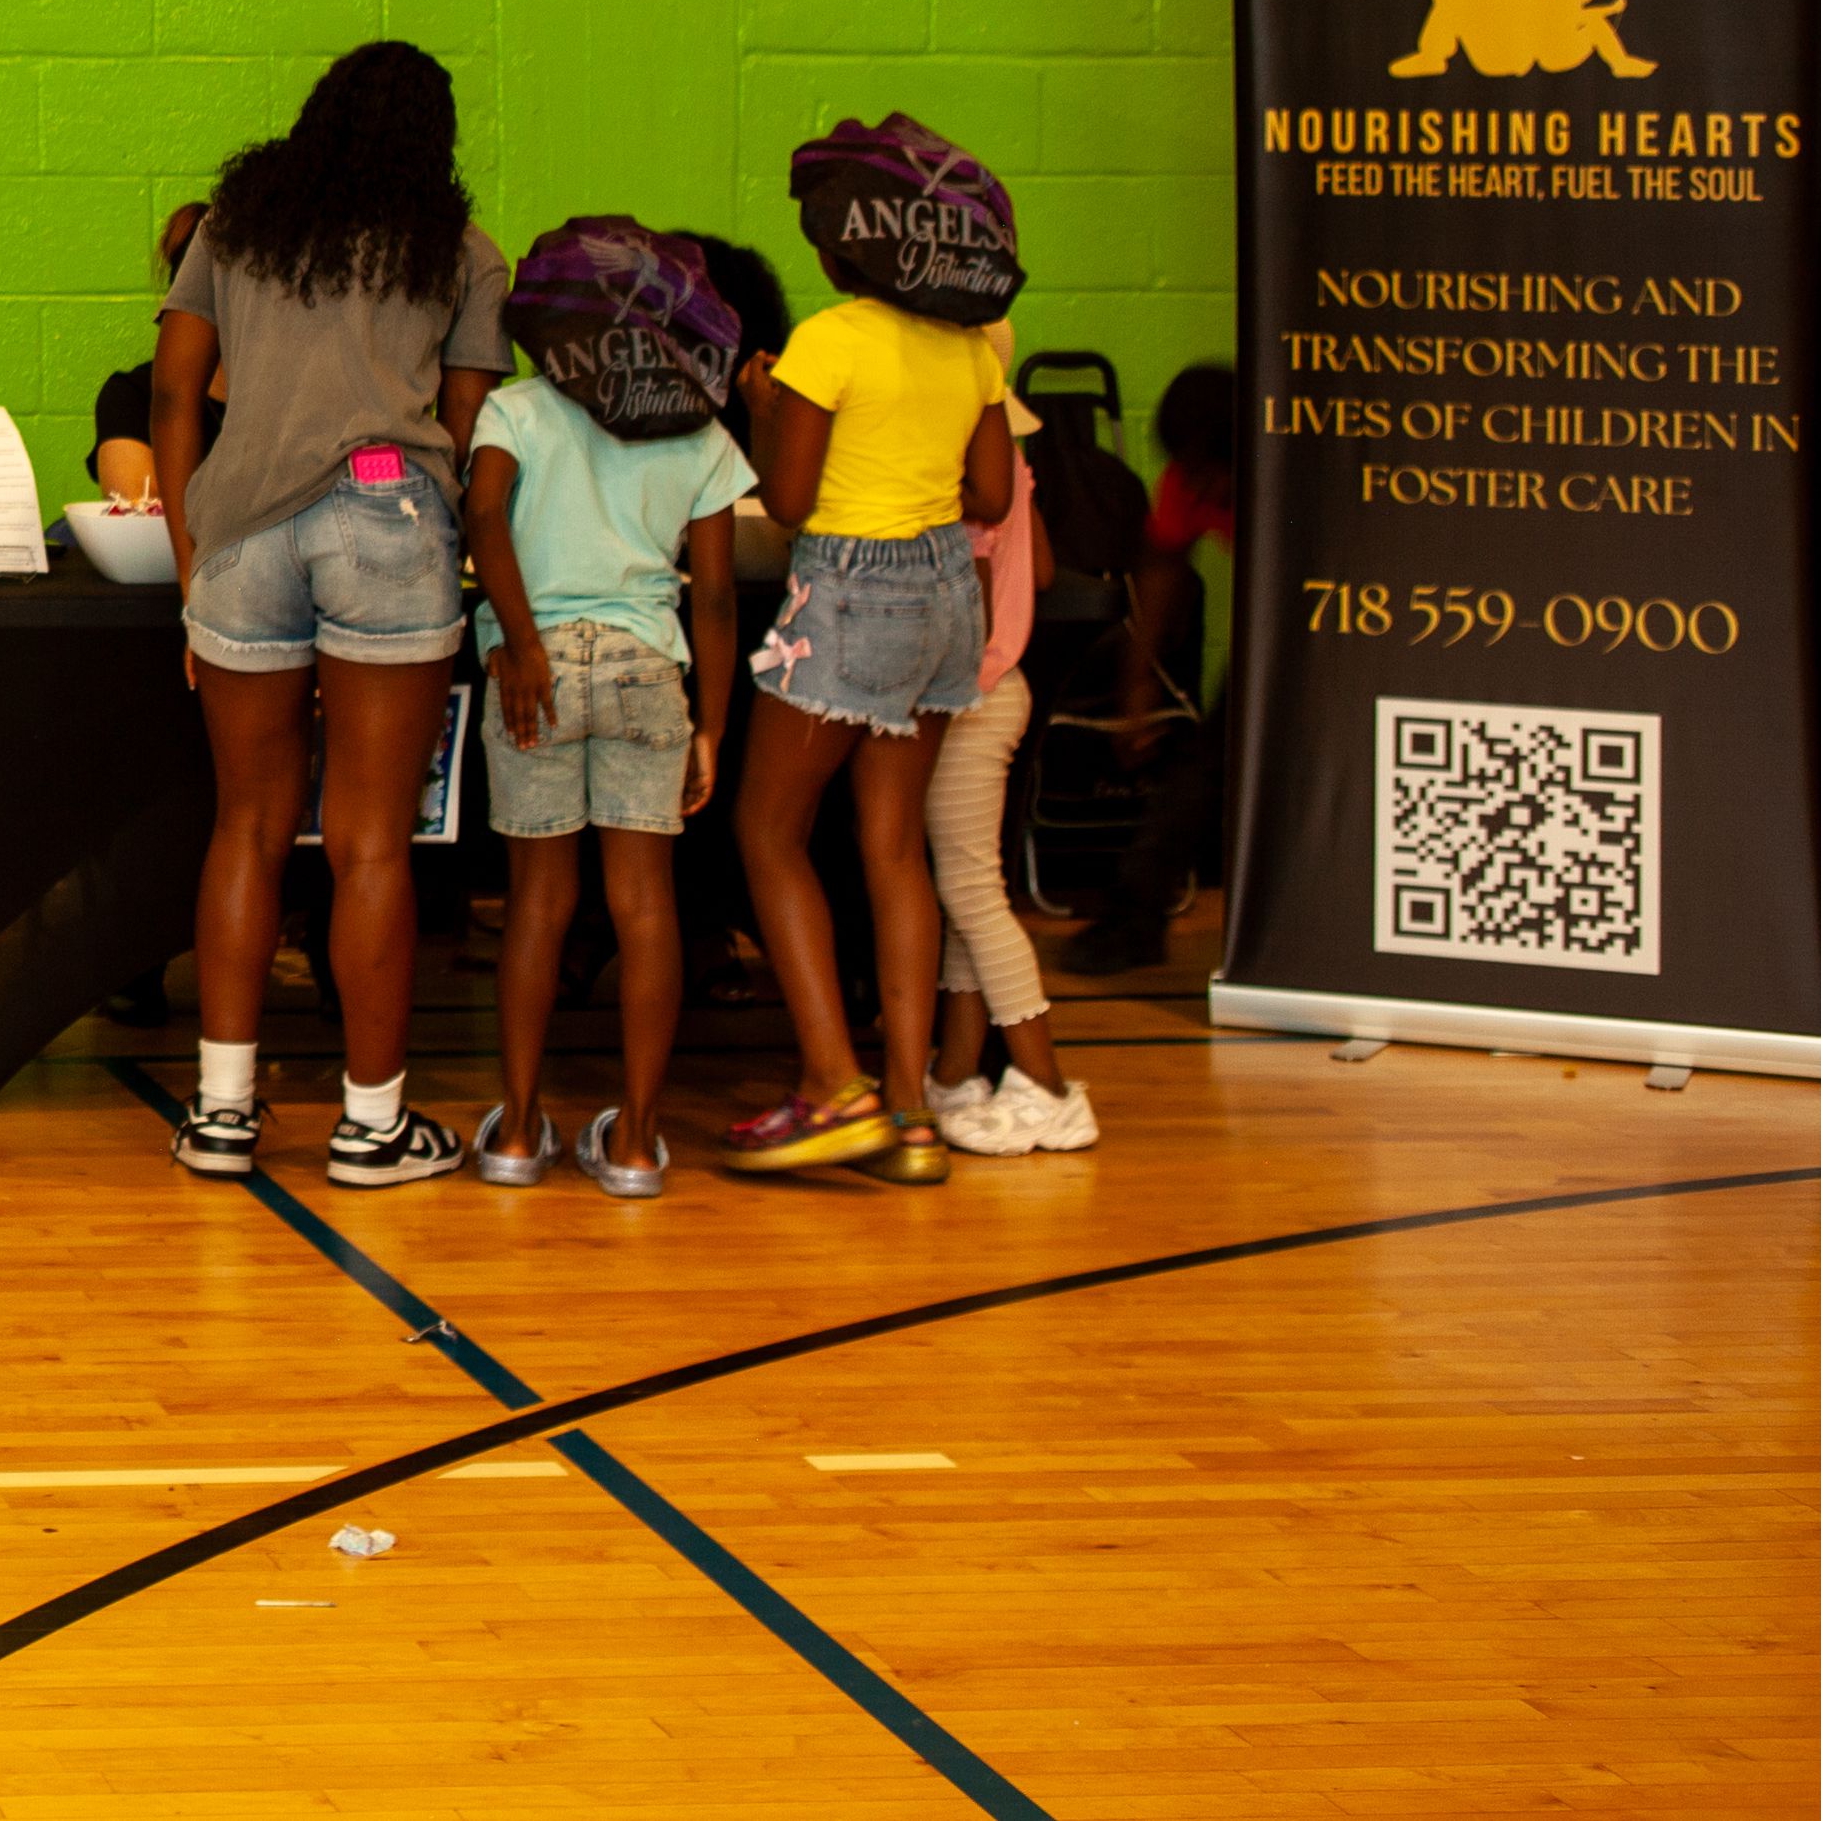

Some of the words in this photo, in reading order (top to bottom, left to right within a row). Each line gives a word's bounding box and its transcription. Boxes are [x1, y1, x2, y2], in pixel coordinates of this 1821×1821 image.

[1263, 107, 1572, 156] NOURISHING
[1598, 110, 1802, 159] HEARTS
[1315, 160, 1383, 196] FEED
[1389, 161, 1444, 198] THE
[1447, 162, 1546, 203] HEART,
[1551, 165, 1621, 201] FUEL
[1627, 165, 1682, 202] THE
[1688, 166, 1765, 203] SOUL
[1315, 268, 1623, 316] NOURISHING
[1630, 276, 1743, 318] AND
[545, 329, 678, 383] ANGEL
[1280, 330, 1668, 383] TRANSFORMING
[1676, 342, 1781, 386] THE
[1263, 396, 1392, 439] LIVES
[1400, 399, 1473, 441] OF
[1481, 403, 1738, 451] CHILDREN
[1751, 412, 1802, 454] IN
[1361, 464, 1549, 512] FOSTER
[1558, 473, 1695, 517] CARE
[1302, 579, 1394, 638] 718
[1407, 583, 1740, 656] 559-0900
